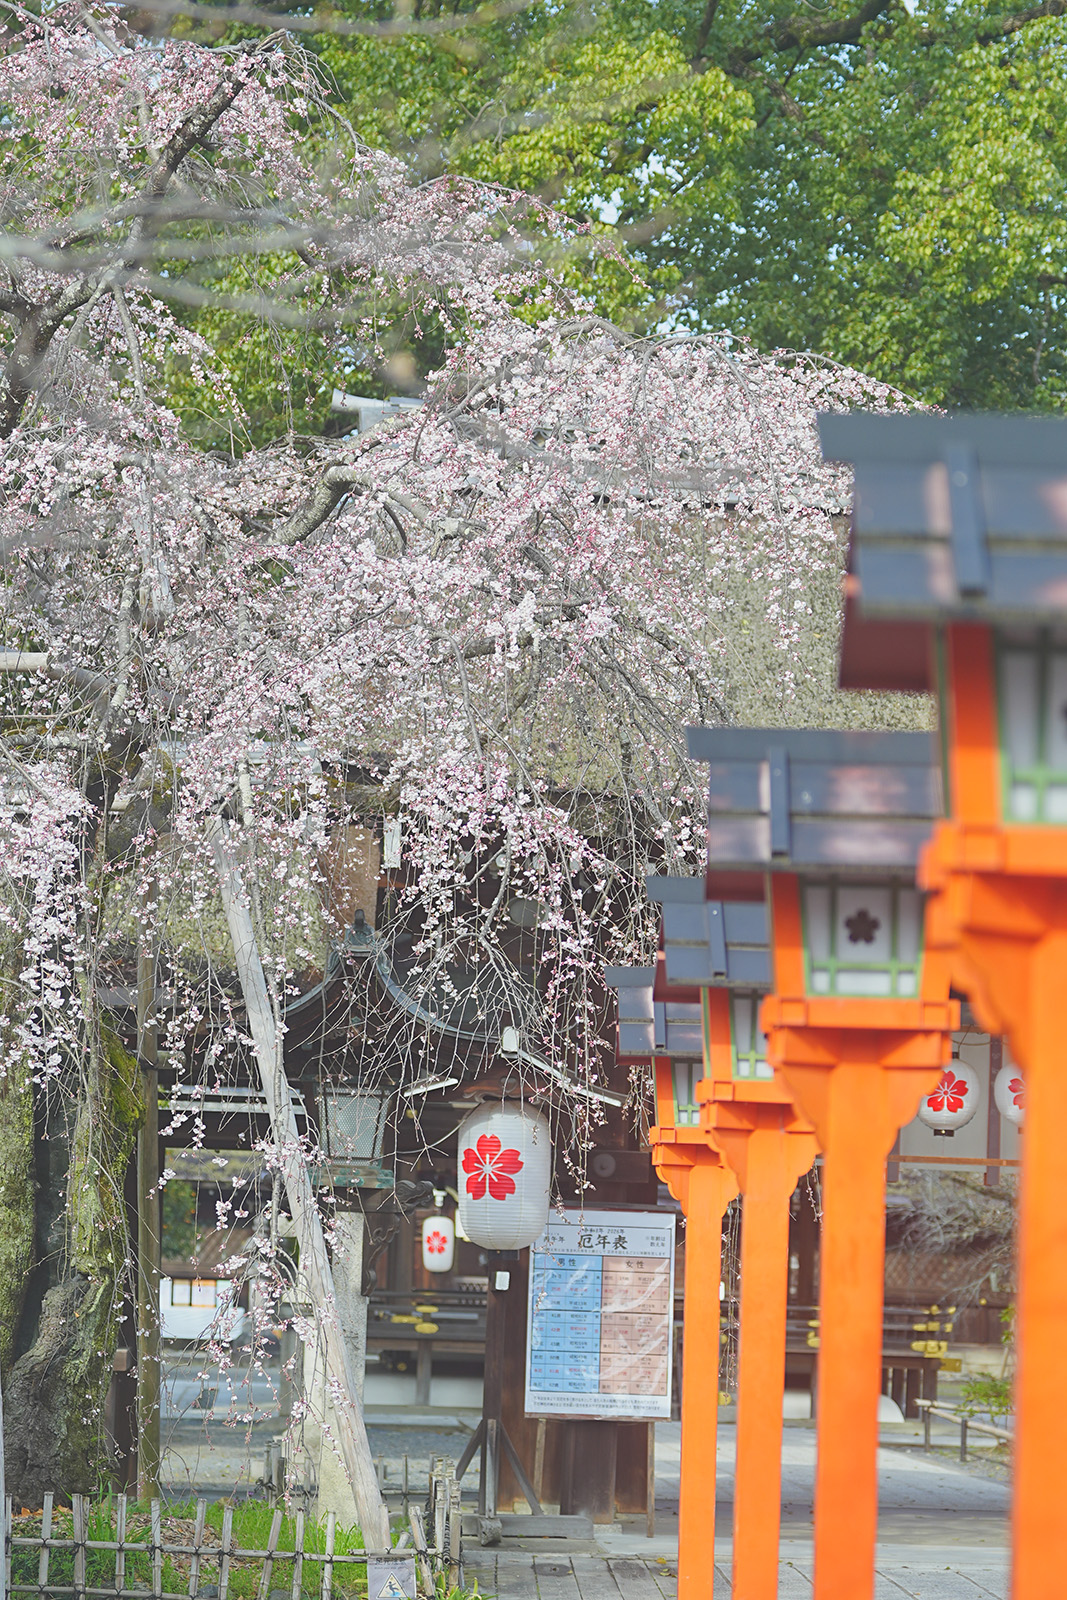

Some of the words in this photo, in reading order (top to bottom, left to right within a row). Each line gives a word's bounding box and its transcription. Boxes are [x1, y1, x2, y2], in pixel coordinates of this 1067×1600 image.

[579, 1233, 629, 1251] 厄年表
[625, 1260, 646, 1270] 女性
